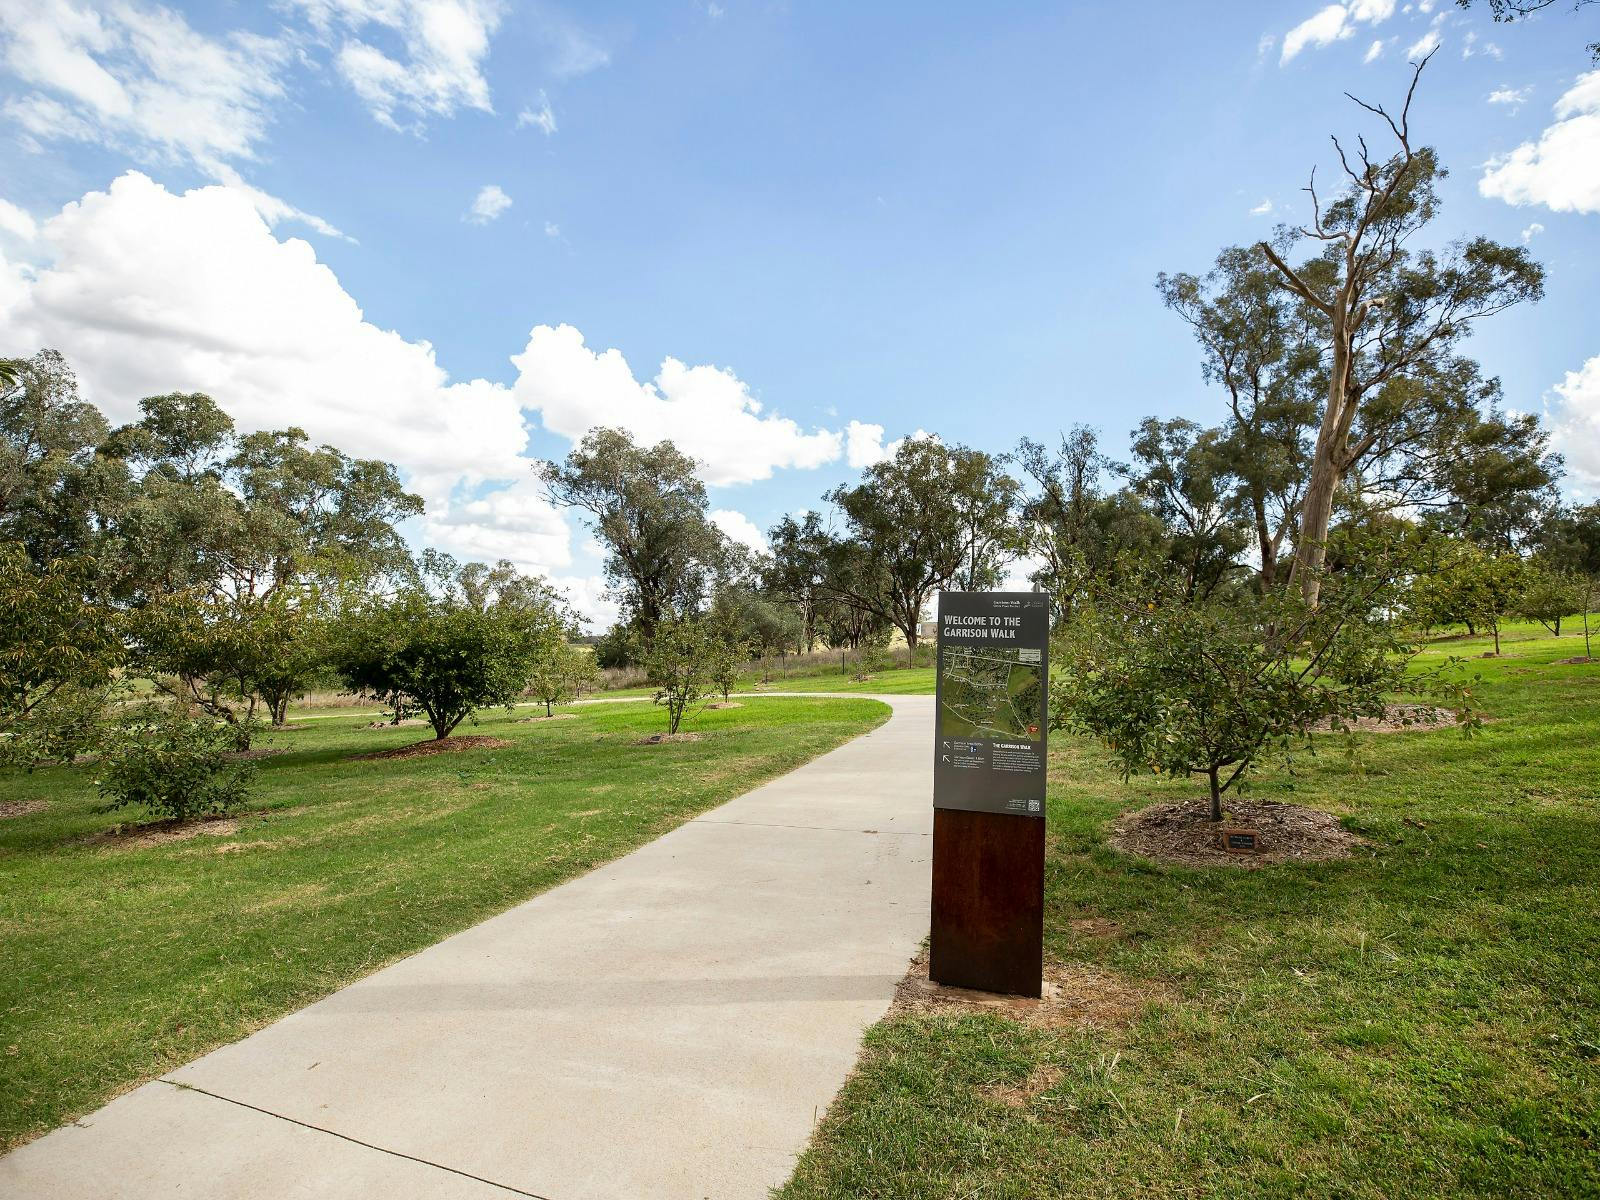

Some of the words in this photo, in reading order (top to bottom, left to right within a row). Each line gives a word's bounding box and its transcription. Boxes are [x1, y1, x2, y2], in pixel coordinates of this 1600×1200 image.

[944, 615, 986, 626] WELCOME
[990, 617, 1001, 626] TO
[1004, 617, 1020, 626] THE
[944, 627, 988, 638] GARRISON
[990, 629, 1016, 638] WALK
